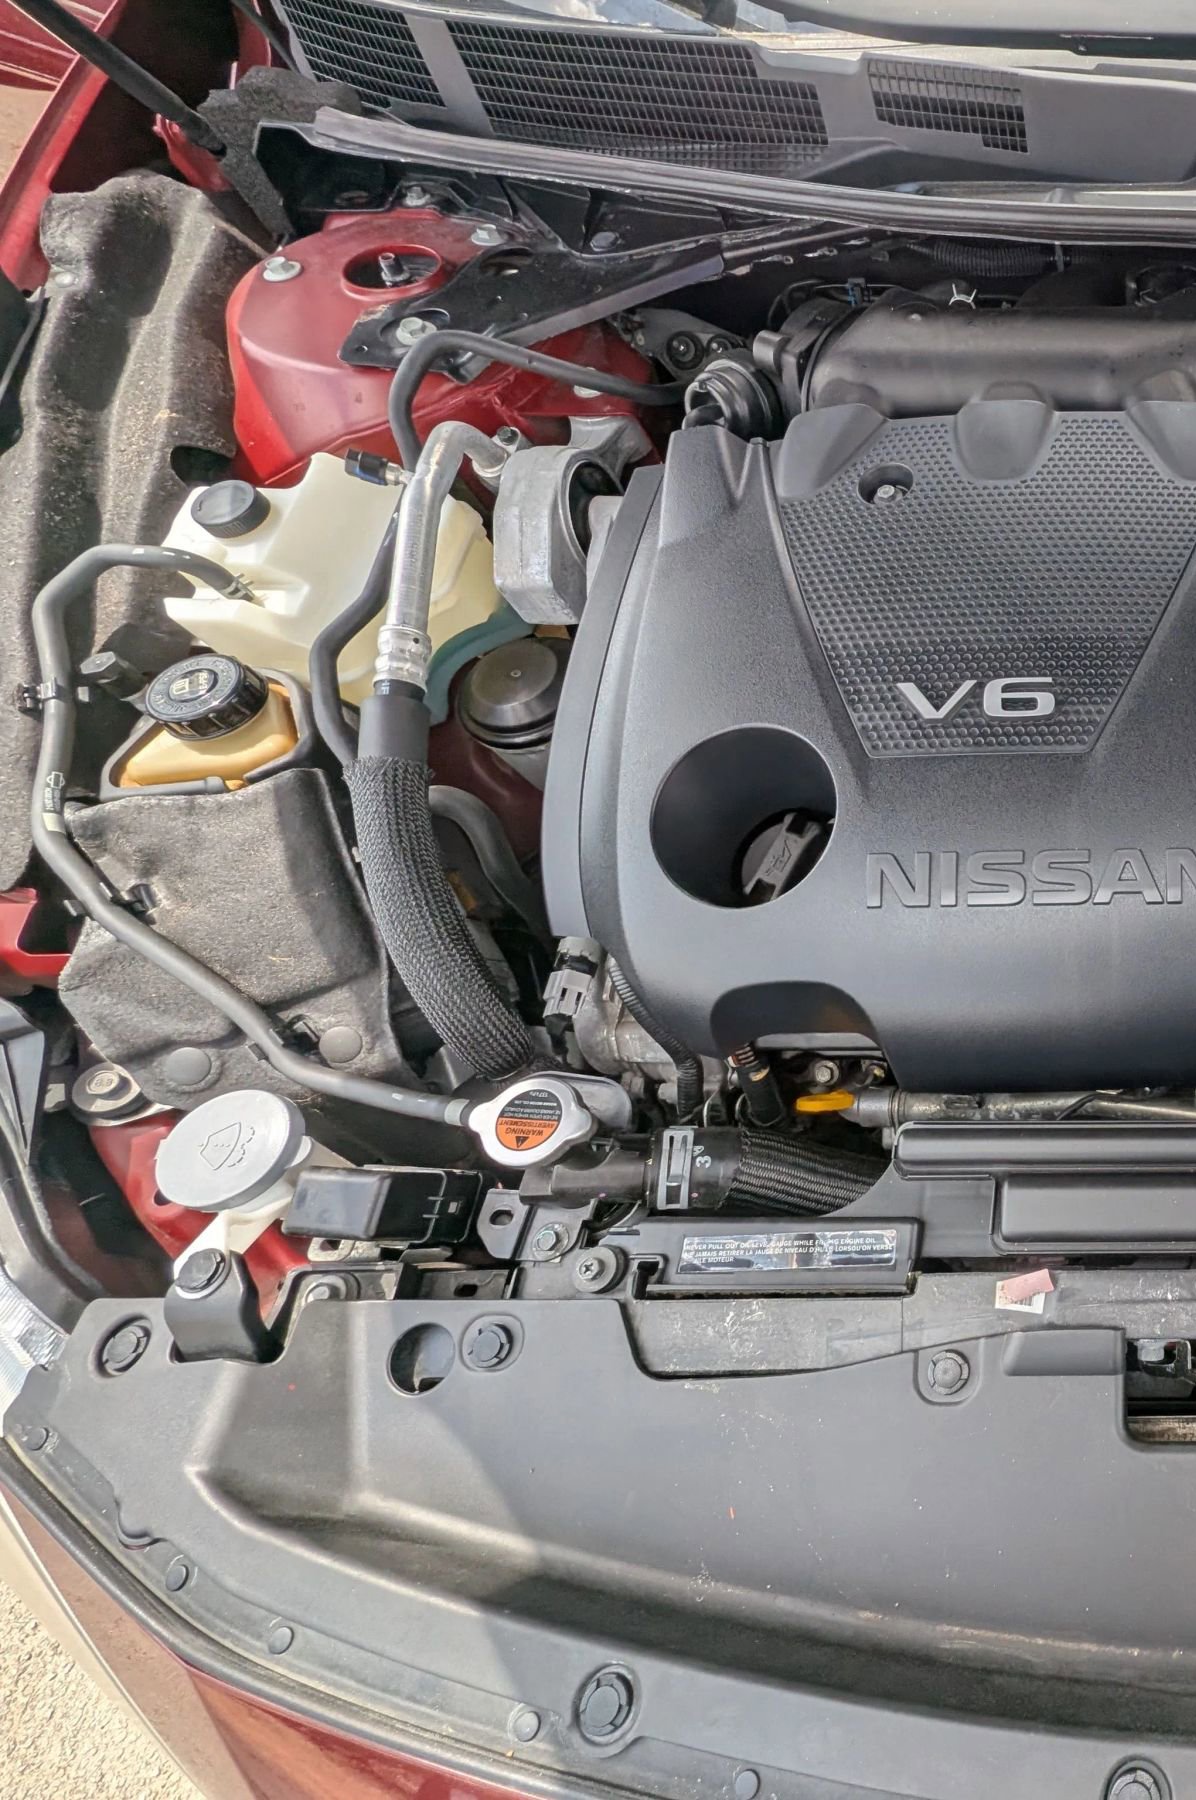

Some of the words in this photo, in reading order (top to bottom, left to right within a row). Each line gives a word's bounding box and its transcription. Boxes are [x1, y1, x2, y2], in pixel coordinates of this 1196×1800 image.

[897, 677, 1055, 719] V6
[498, 1119, 554, 1127] AVERTISSEMENT
[505, 1127, 543, 1135] WARNING
